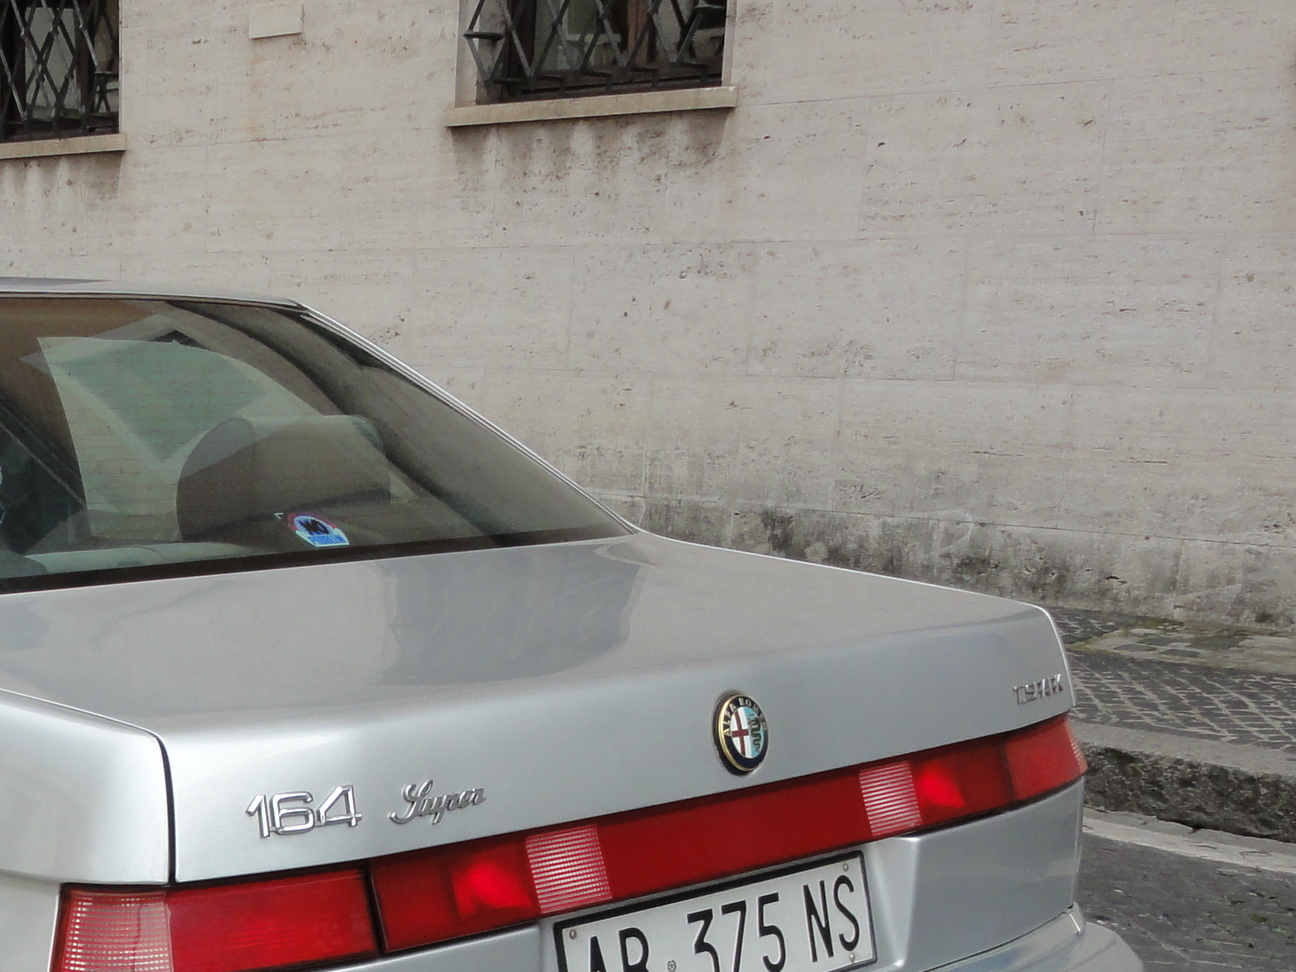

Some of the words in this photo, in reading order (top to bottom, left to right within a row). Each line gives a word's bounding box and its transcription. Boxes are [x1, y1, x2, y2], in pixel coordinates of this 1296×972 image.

[723, 703, 738, 737] ALFA
[245, 784, 363, 838] 164
[389, 779, 486, 825] Super
[803, 874, 860, 962] NS
